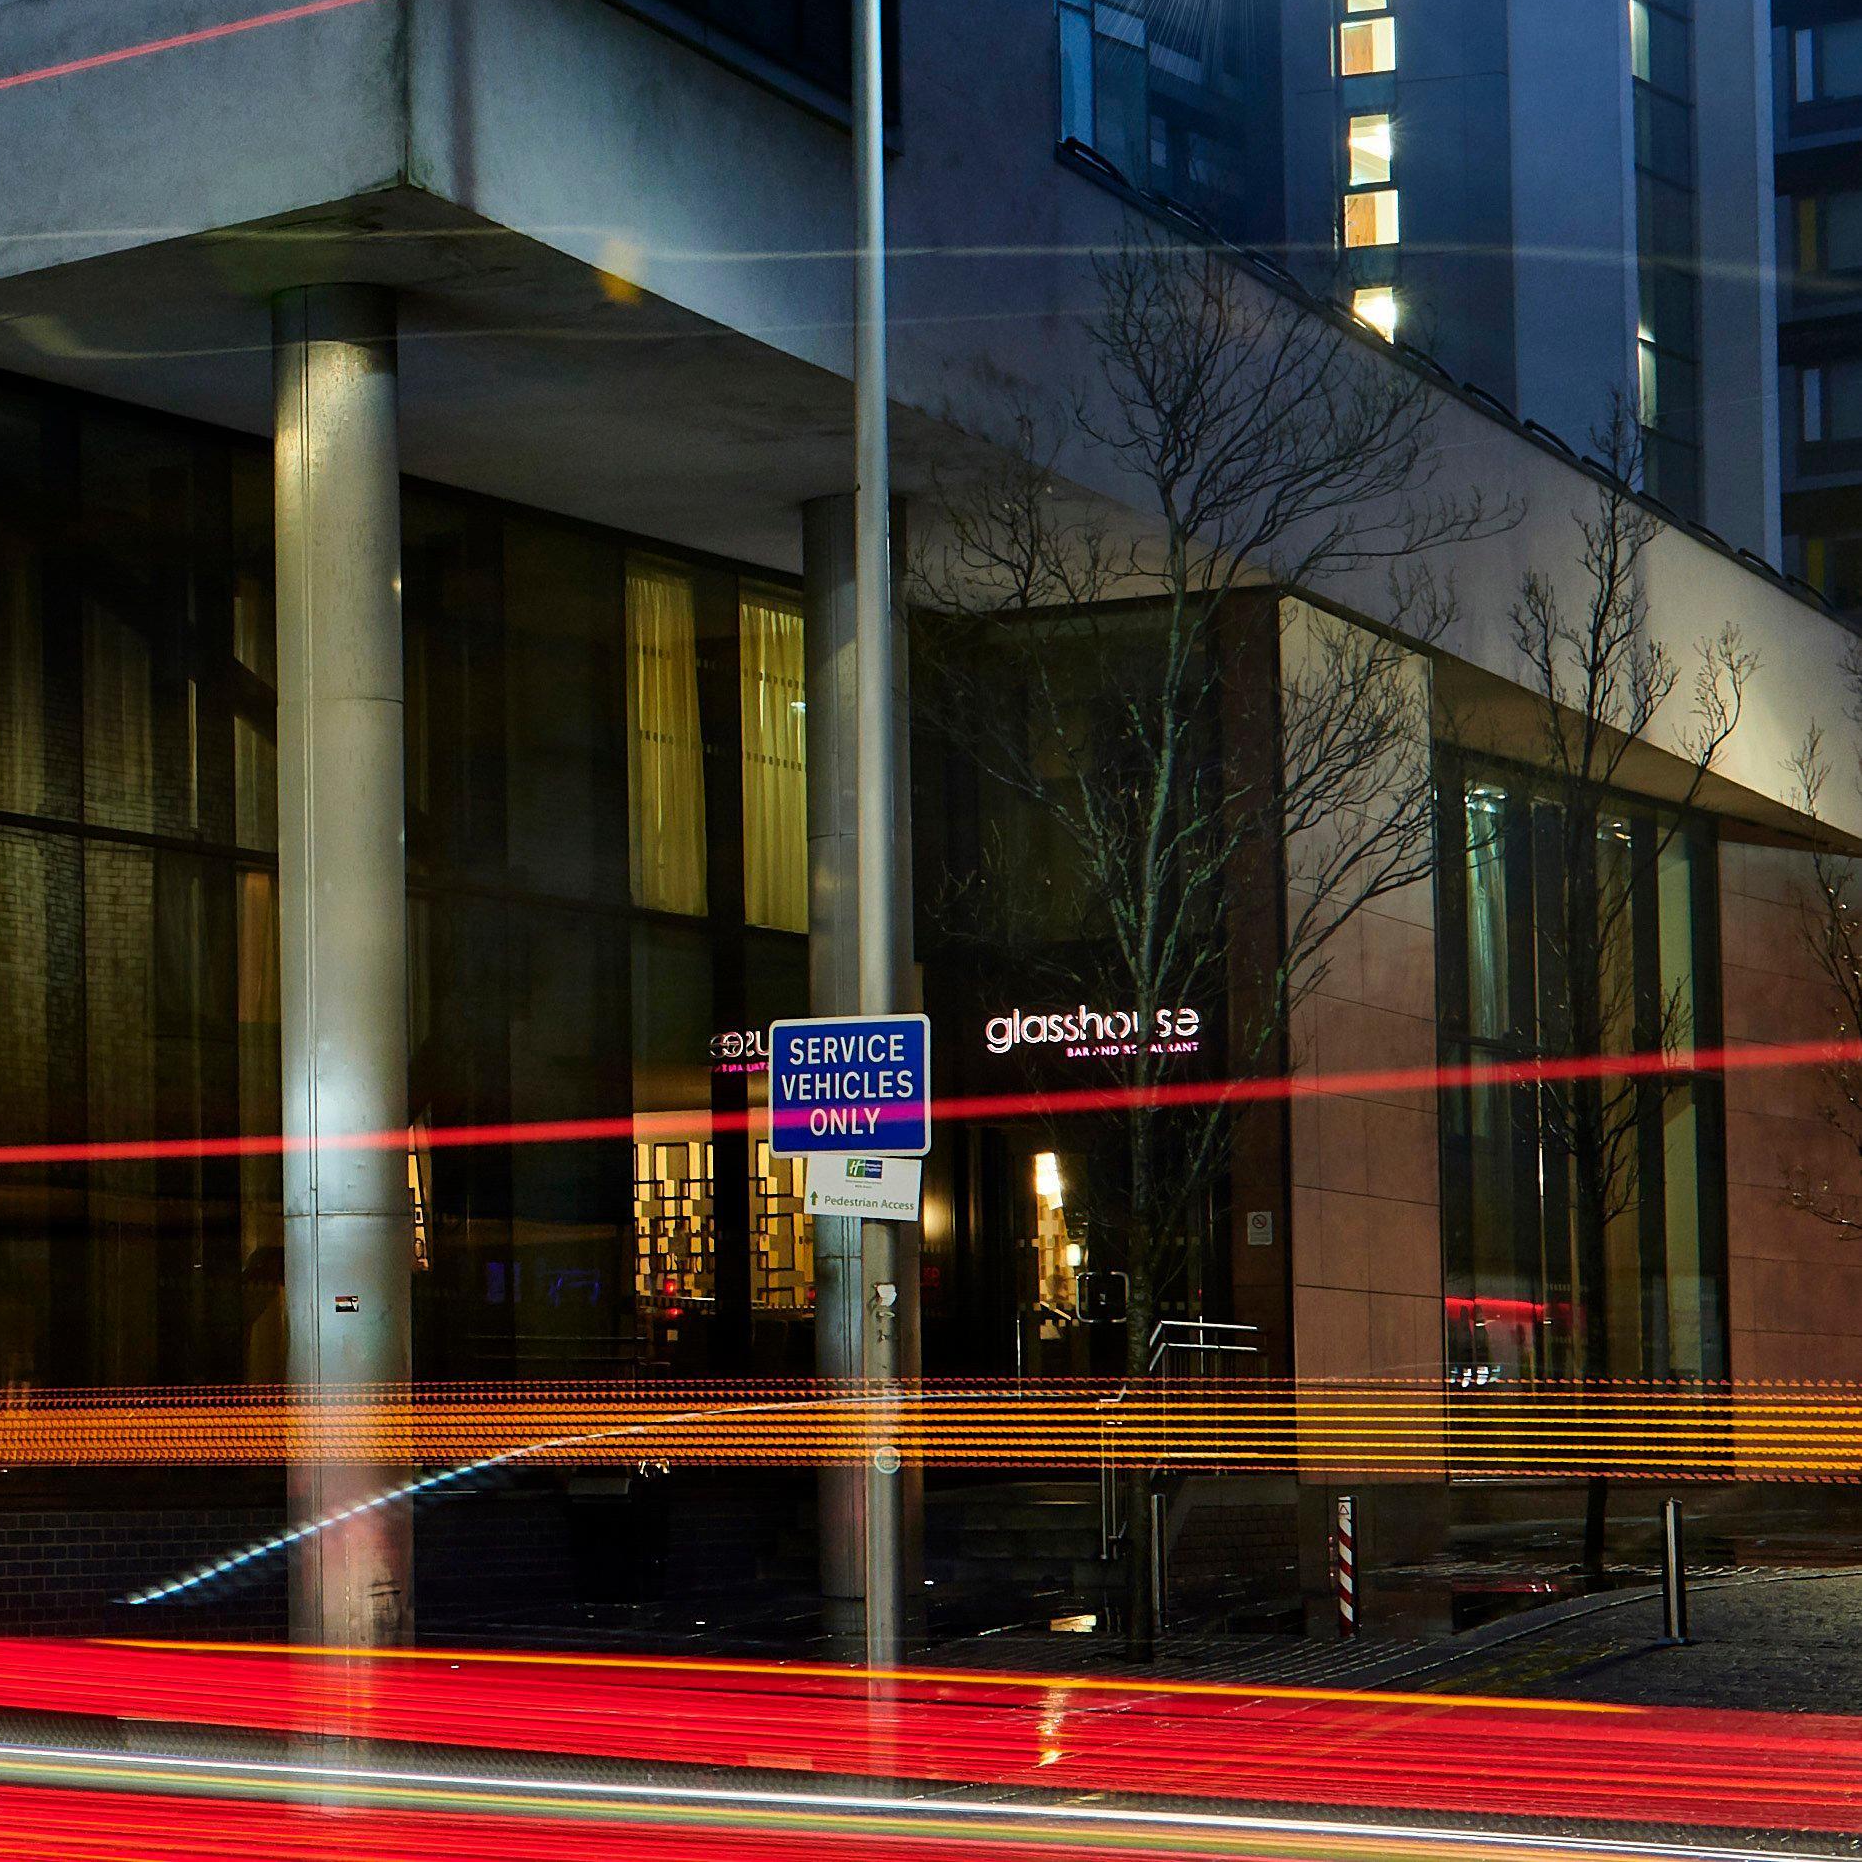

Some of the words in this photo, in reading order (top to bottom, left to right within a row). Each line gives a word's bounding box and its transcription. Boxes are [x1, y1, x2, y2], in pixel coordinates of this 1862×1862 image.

[789, 1034, 905, 1066] SERVICE
[1065, 1046, 1091, 1058] BAR
[781, 1070, 914, 1101] VEHICLES
[809, 1107, 881, 1136] ONLY
[824, 1195, 878, 1209] Pedestrian
[880, 1199, 915, 1211] Access
